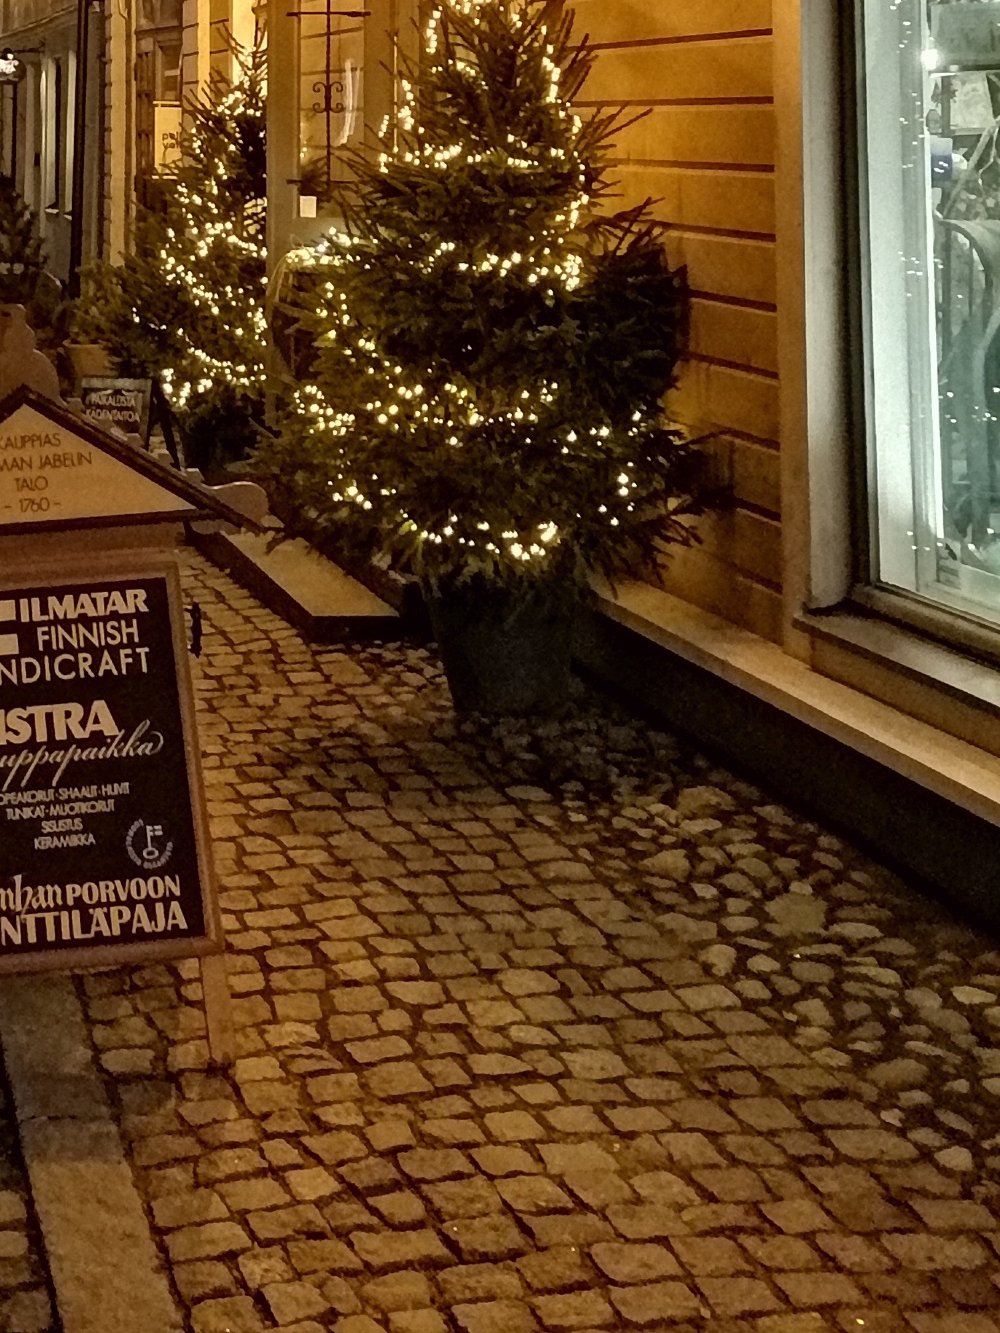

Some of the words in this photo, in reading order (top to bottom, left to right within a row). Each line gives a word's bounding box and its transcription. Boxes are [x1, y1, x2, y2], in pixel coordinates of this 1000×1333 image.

[14, 475, 49, 492] TALO
[18, 497, 50, 513] 1760
[19, 589, 149, 623] ILMATAR
[36, 618, 139, 652] FINNISH
[65, 874, 181, 906] PORVOON
